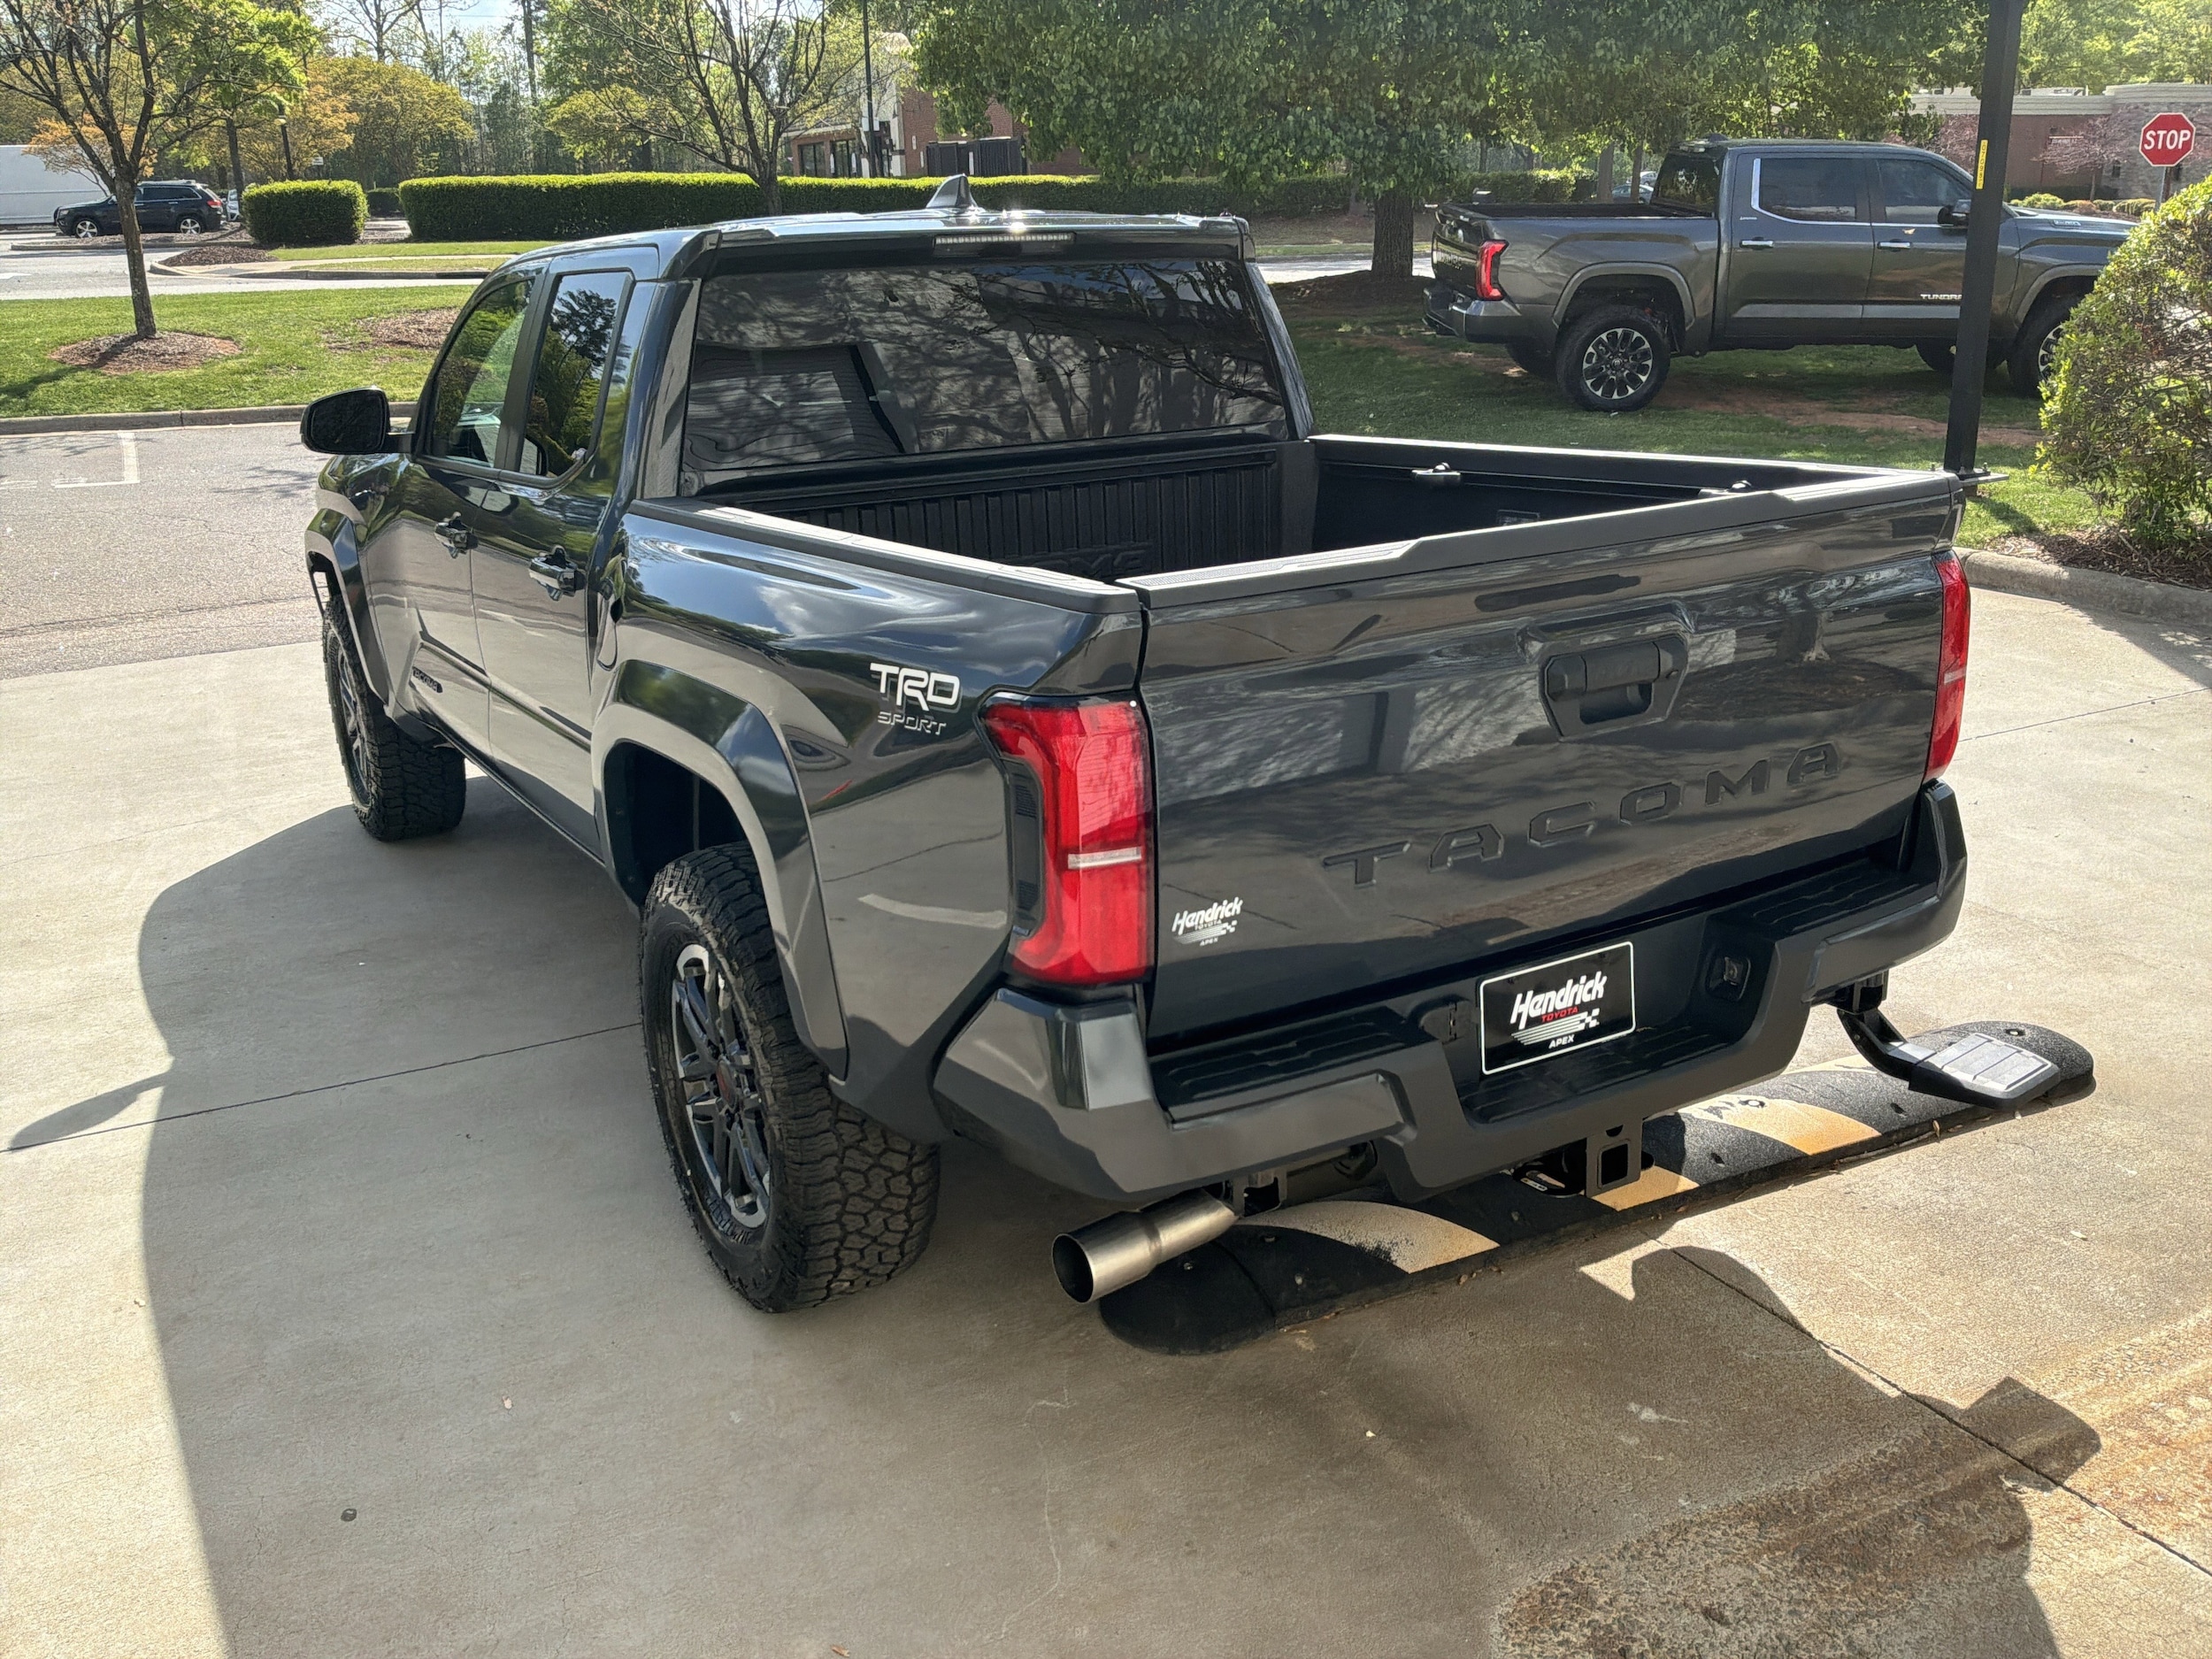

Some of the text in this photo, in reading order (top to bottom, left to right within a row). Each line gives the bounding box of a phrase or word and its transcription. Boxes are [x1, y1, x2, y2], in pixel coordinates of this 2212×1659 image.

[2144, 129, 2192, 150] STOP
[870, 662, 960, 711] TRD
[878, 711, 947, 735] SPORT
[1322, 741, 1841, 887] TACOMA
[1171, 896, 1243, 935] Hendrick
[1194, 918, 1222, 930] TOYOTA
[1200, 937, 1218, 947] APEX
[1509, 971, 1608, 1030] Hendrick
[1541, 1006, 1579, 1023] TOYOTA
[1548, 1034, 1575, 1049] APEX
